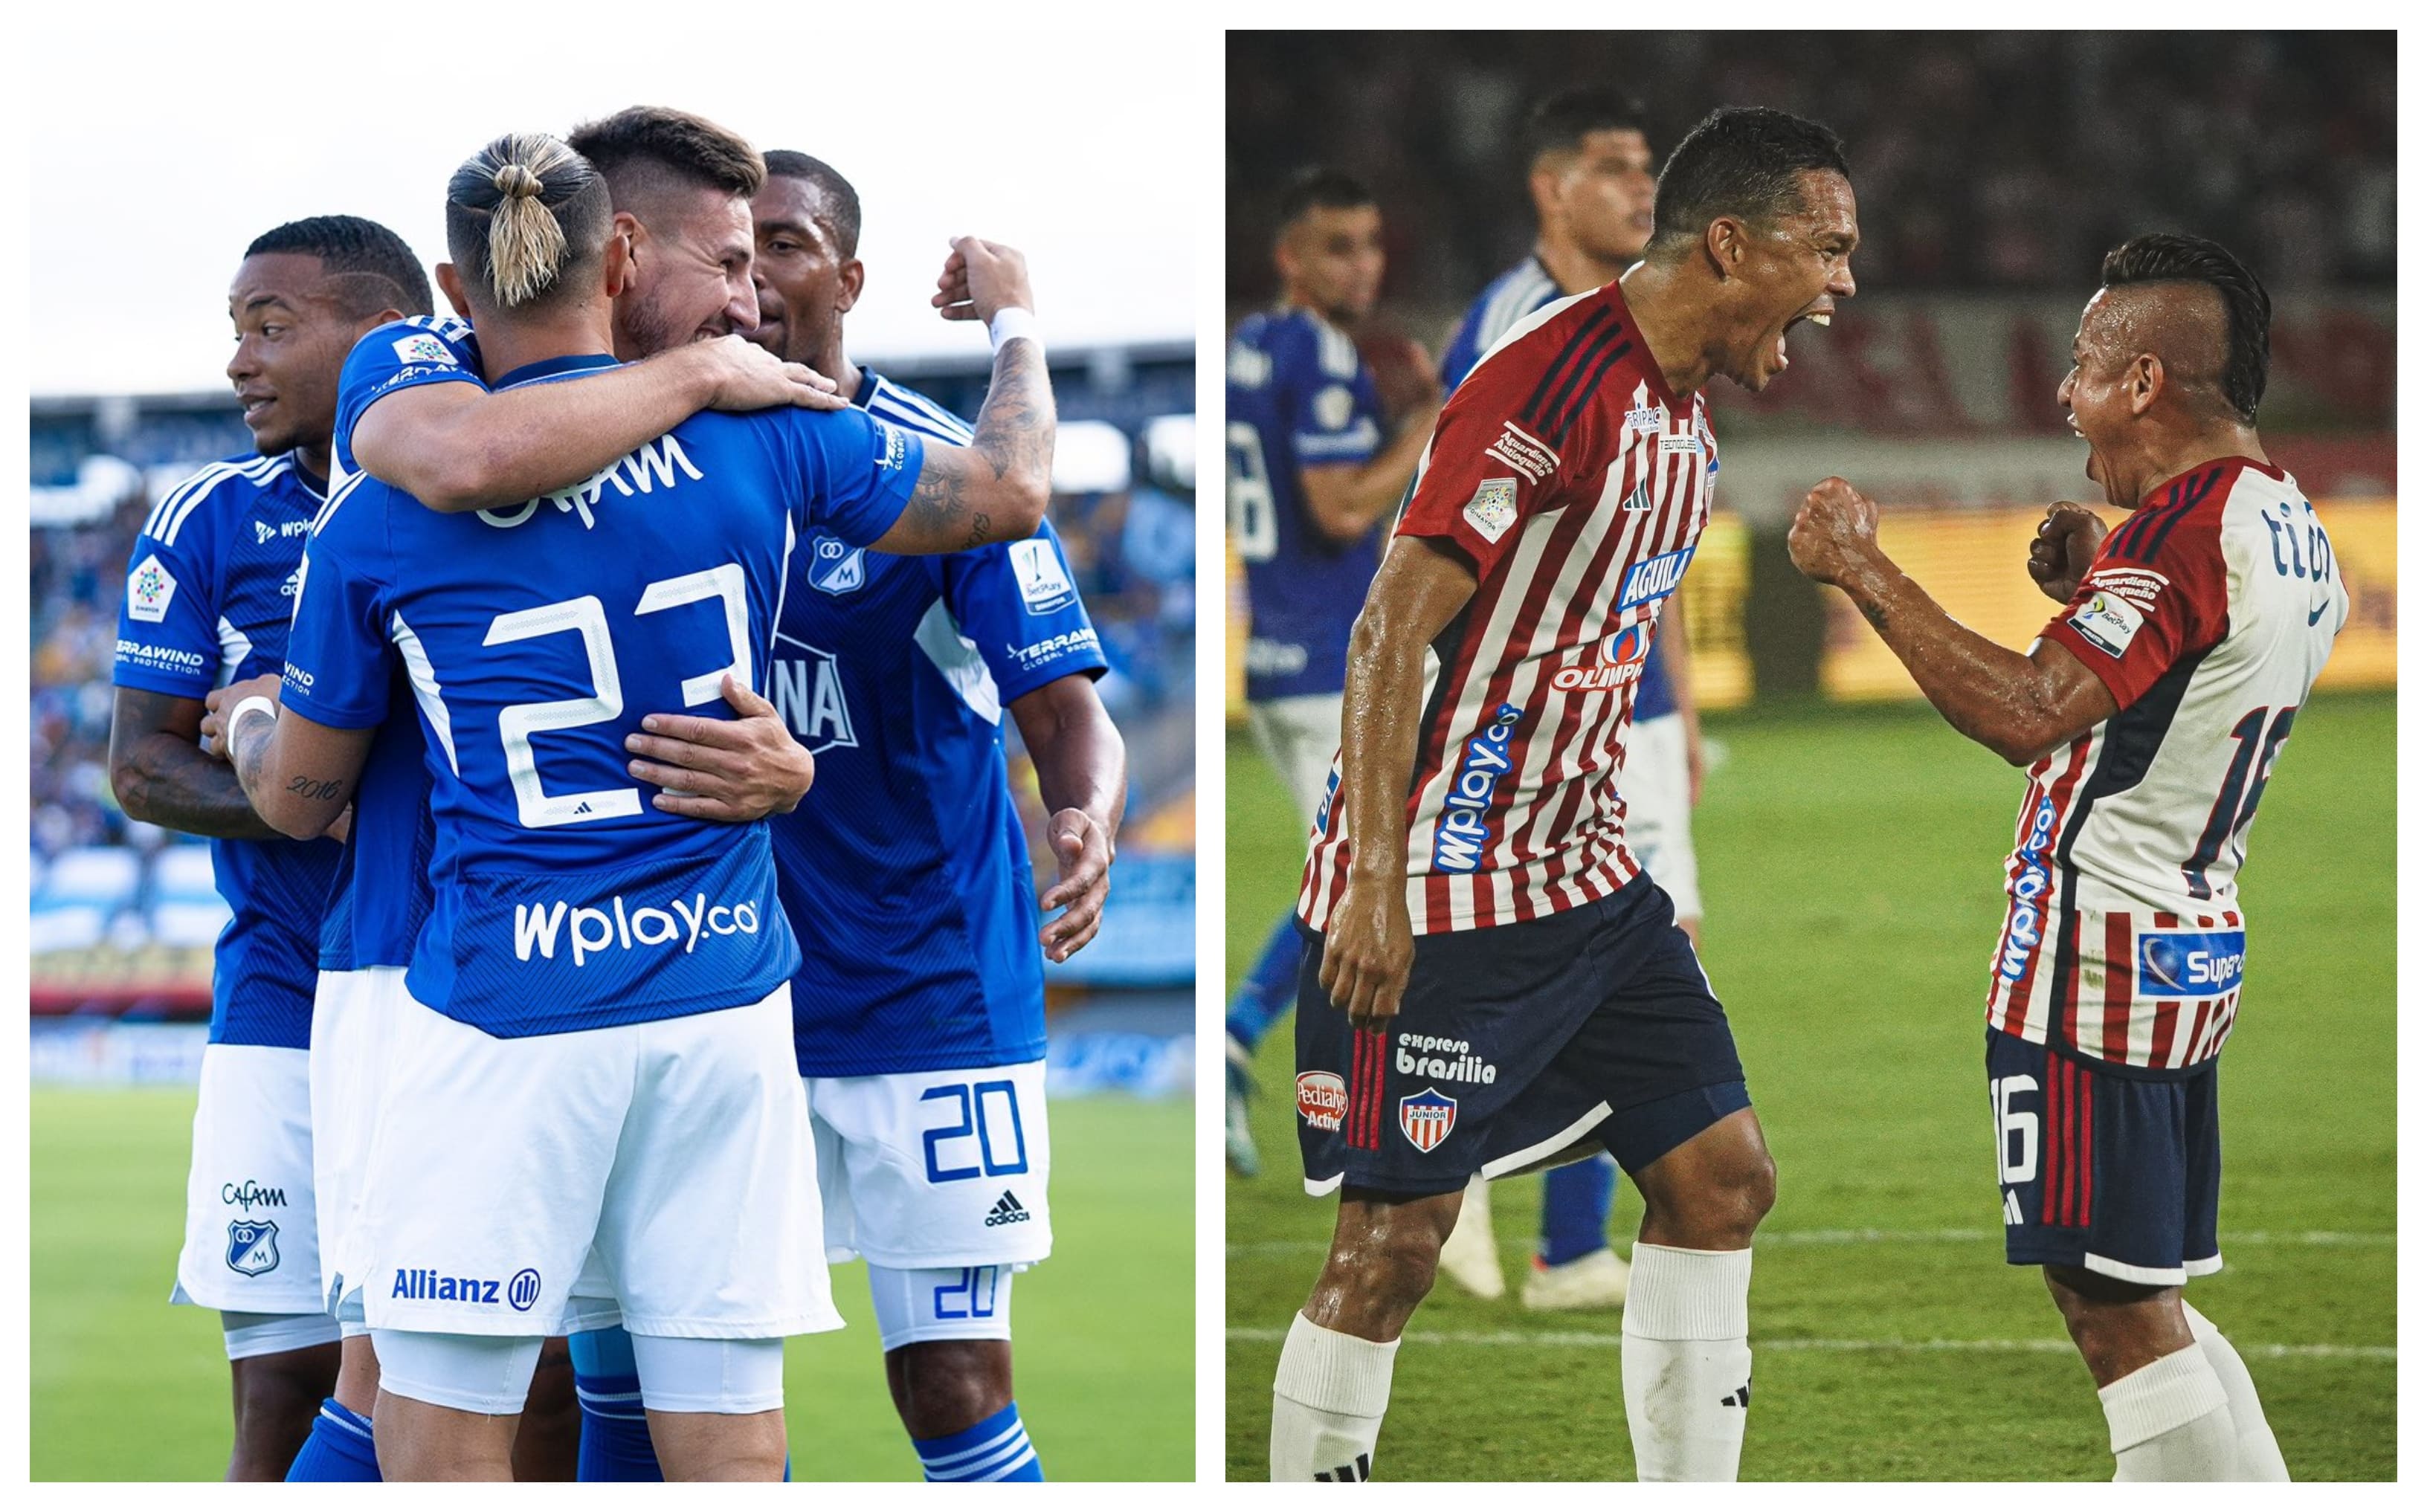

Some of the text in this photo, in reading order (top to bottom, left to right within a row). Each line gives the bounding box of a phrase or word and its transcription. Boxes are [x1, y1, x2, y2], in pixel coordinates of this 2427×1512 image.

[1493, 439, 1546, 477] Antioqueño
[1500, 430, 1554, 474] Aguardiente
[1622, 550, 1690, 607] AGUILA
[2089, 577, 2162, 592] Aguardiente
[2101, 613, 2132, 634] BetPlay
[481, 563, 752, 829] 23
[286, 775, 343, 801] 2016
[1438, 711, 1519, 870] Wplay.co
[514, 892, 758, 967] Wplay.co
[1399, 1033, 1469, 1054] expreso
[1396, 1047, 1496, 1084] brasilia
[919, 1079, 1028, 1183] 20
[1409, 1108, 1447, 1120] JUNIOR
[984, 1210, 1030, 1227] adidas
[392, 1269, 500, 1303] Allianz
[934, 1264, 998, 1320] 20
